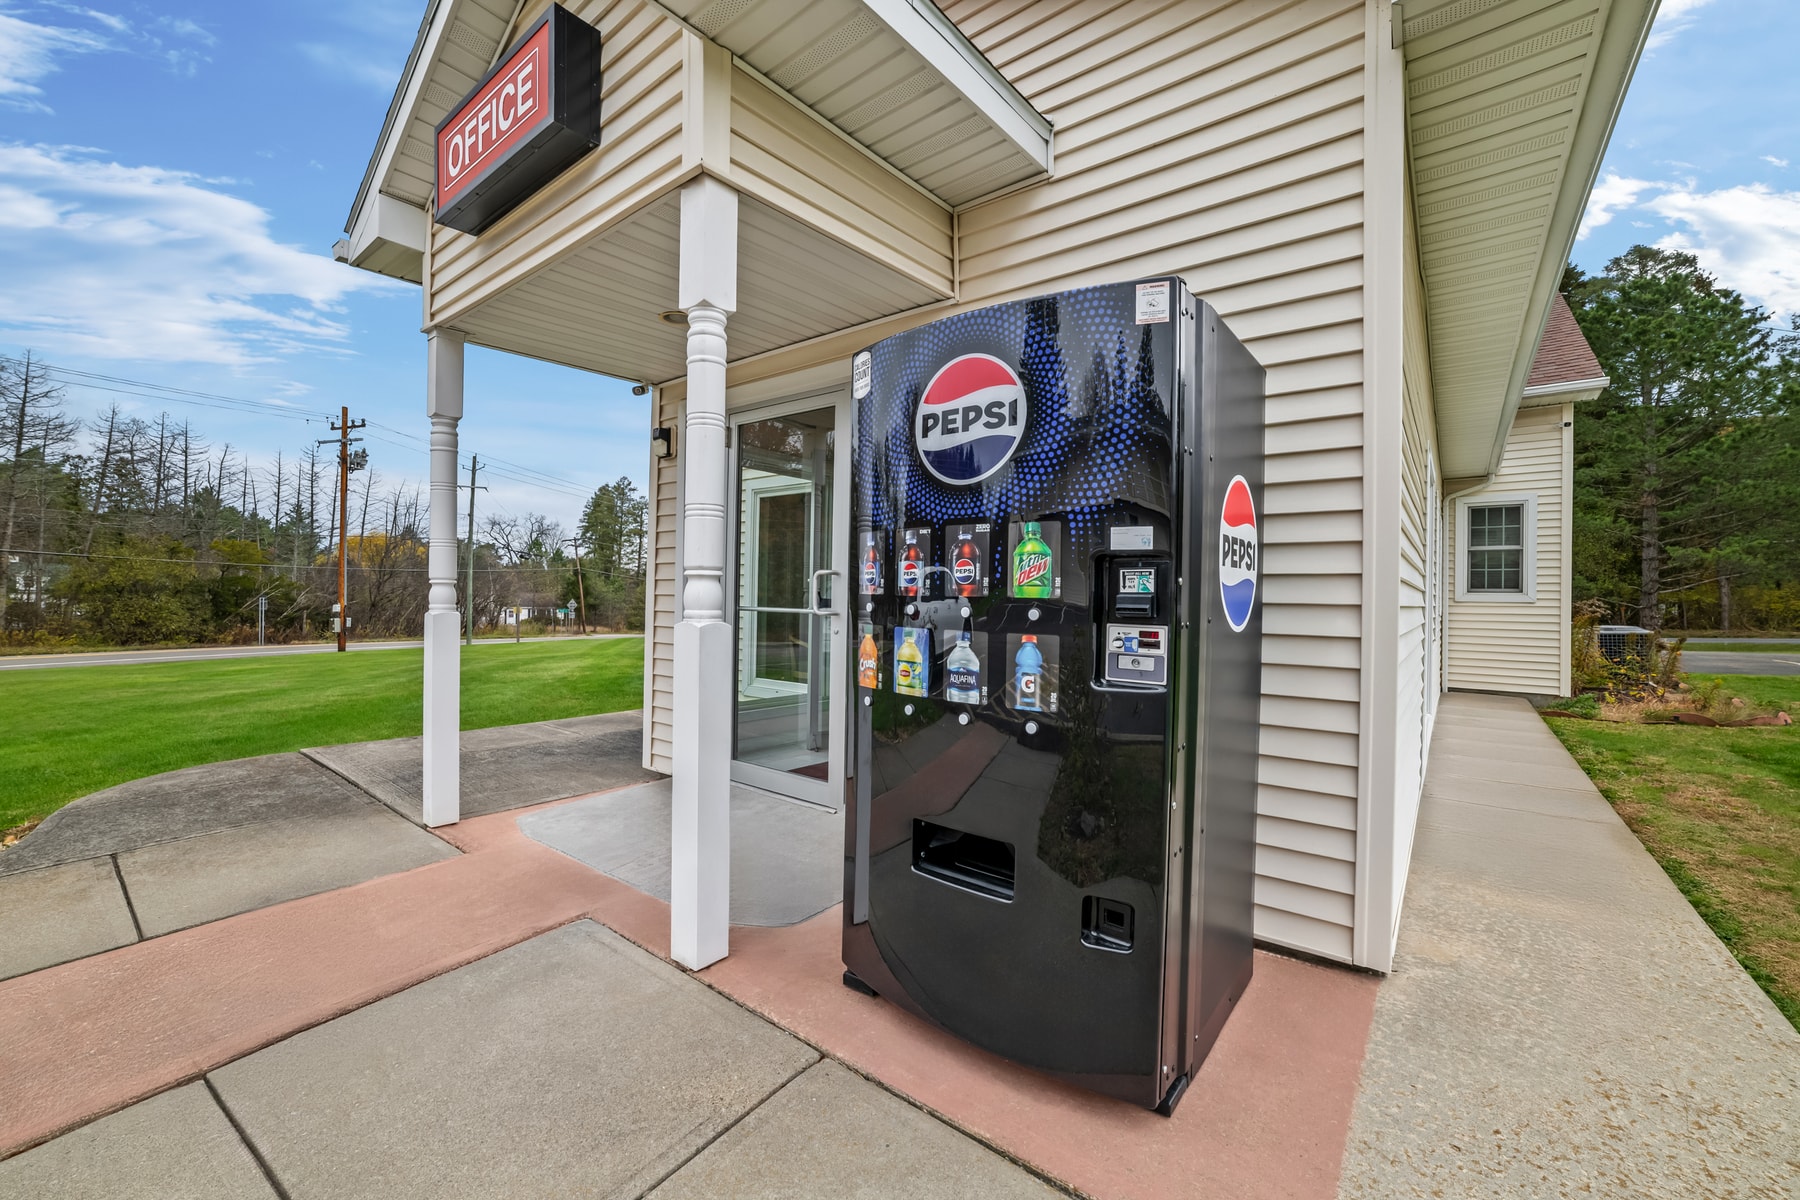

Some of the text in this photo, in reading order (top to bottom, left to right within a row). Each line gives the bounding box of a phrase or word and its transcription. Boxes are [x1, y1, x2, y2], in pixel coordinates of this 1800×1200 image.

[448, 62, 533, 178] OFFICE
[921, 397, 1018, 439] PEPSI
[1222, 533, 1256, 572] PEPSI
[859, 658, 876, 670] Crush
[950, 673, 977, 686] AQUAFINA
[1021, 676, 1035, 693] G
